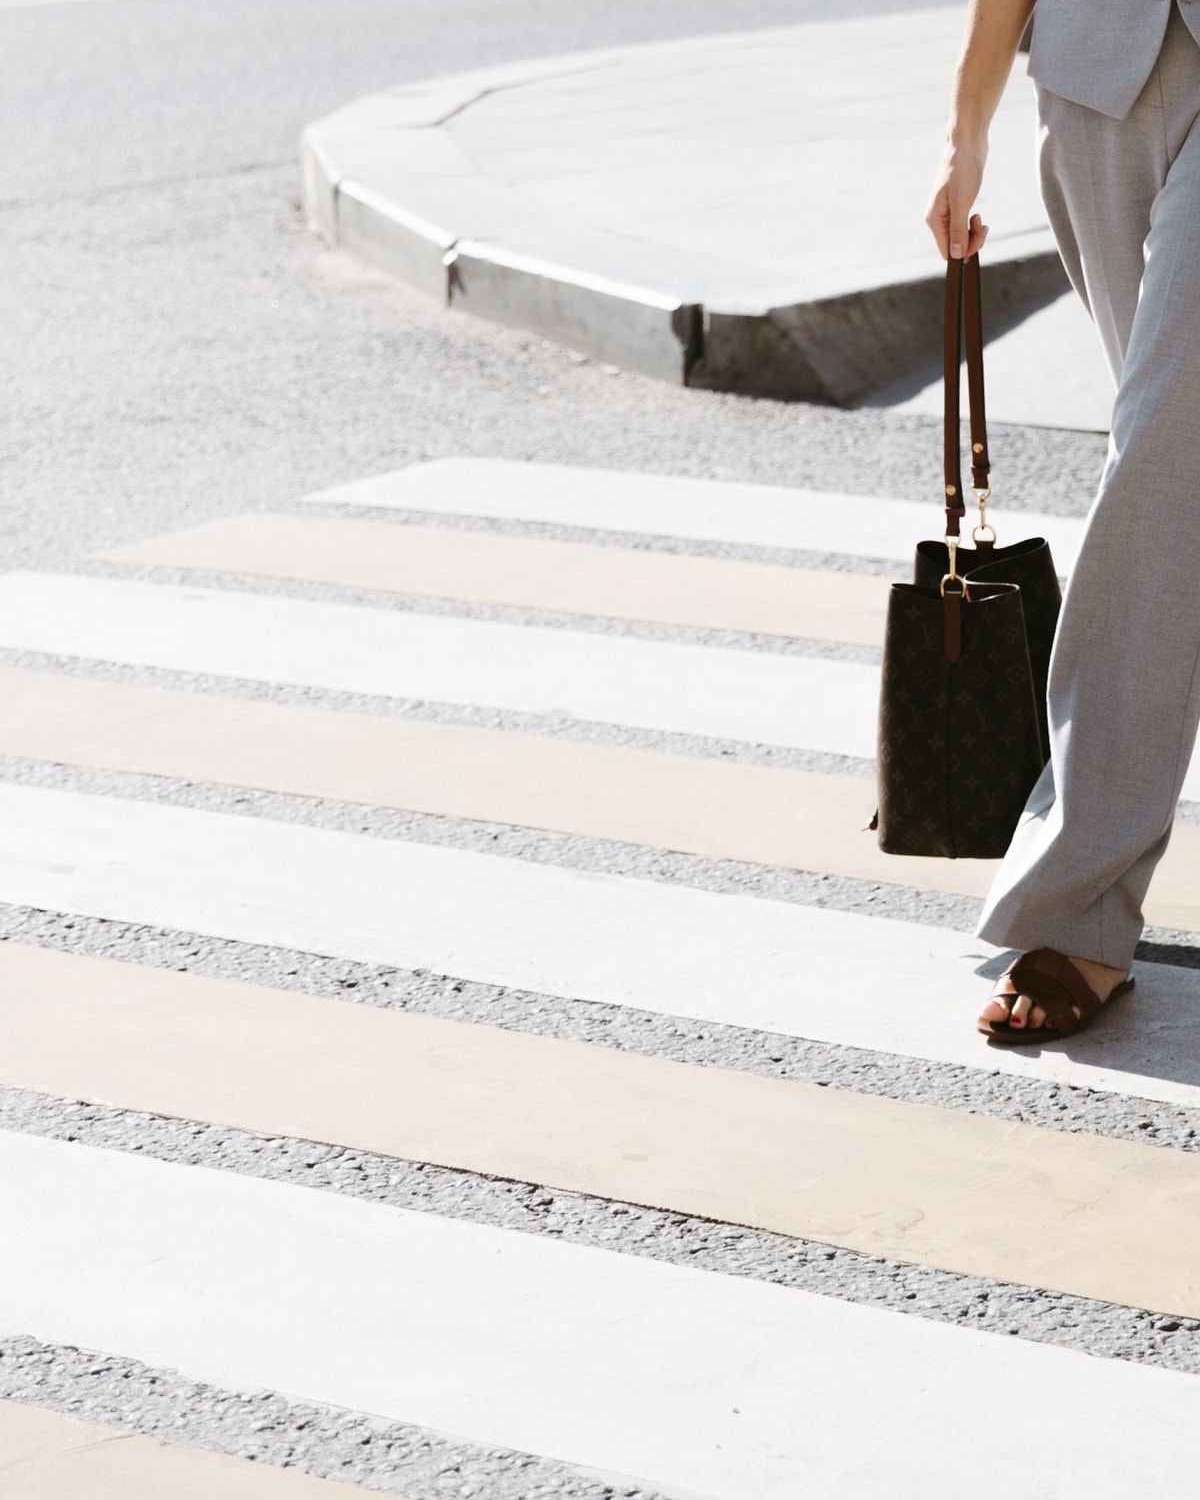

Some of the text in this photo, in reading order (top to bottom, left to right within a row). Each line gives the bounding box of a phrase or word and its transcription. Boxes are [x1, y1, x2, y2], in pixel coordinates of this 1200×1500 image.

[919, 623, 942, 649] LV
[909, 706, 928, 733] LV
[974, 706, 995, 733] LV
[903, 788, 921, 816] LV
[981, 788, 1006, 816] LV
